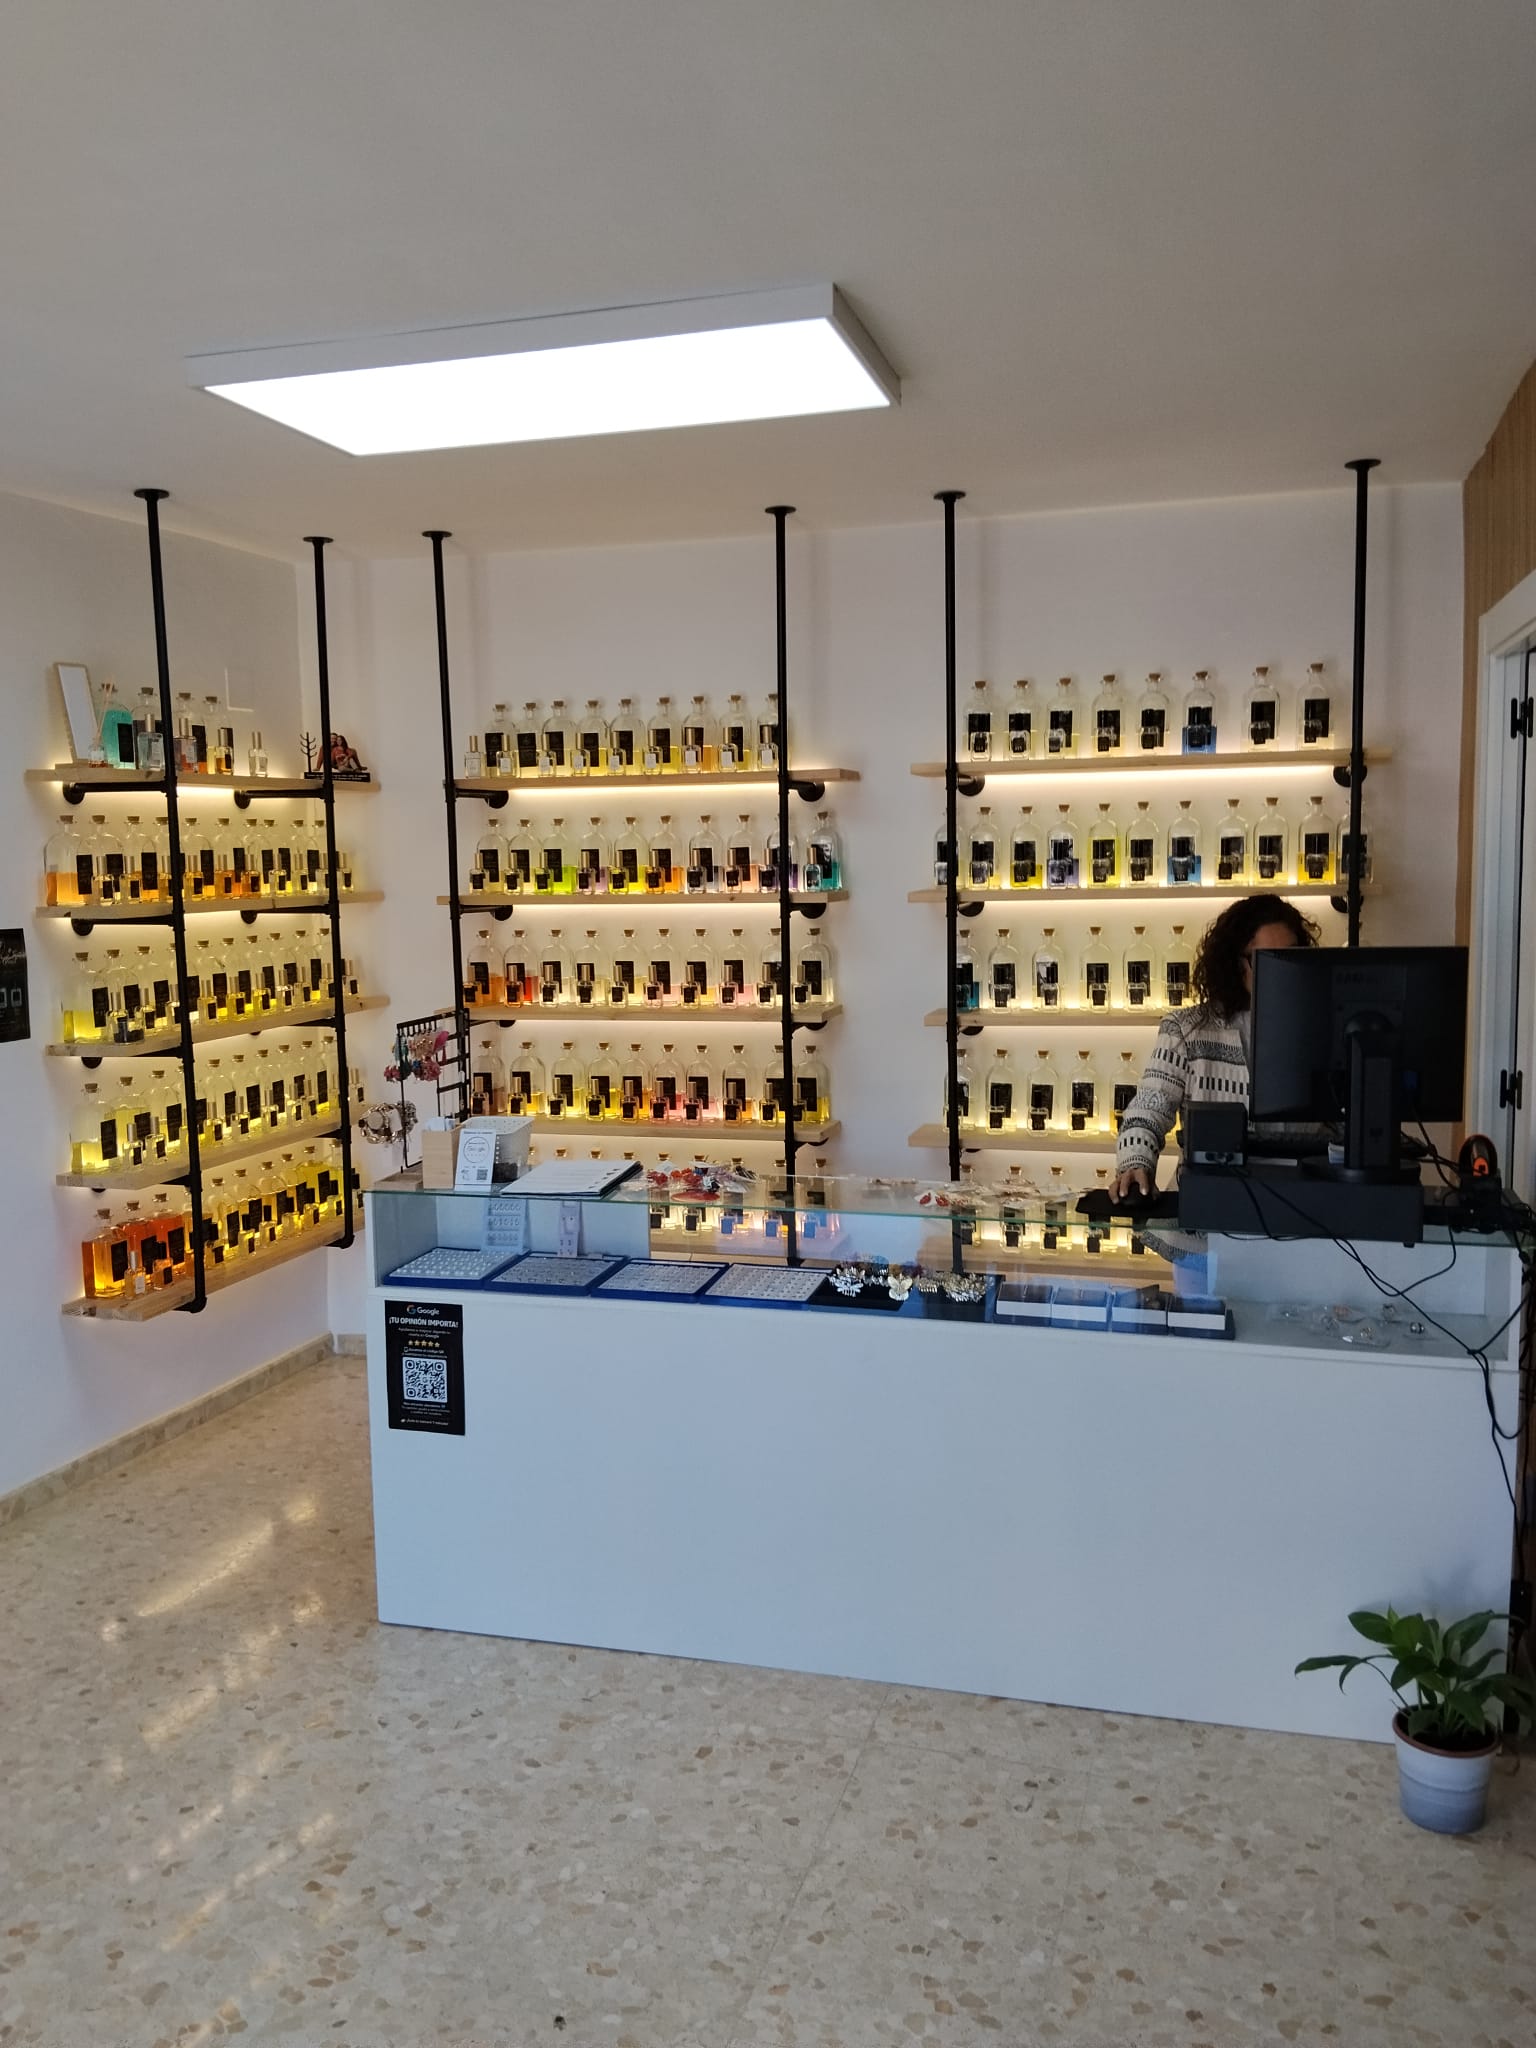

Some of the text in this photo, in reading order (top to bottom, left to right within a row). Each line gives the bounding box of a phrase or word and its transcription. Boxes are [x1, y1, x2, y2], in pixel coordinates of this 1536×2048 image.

[417, 1306, 440, 1316] Google
[389, 1316, 459, 1328] ¡TU OPINIÓN IMPORTA!
